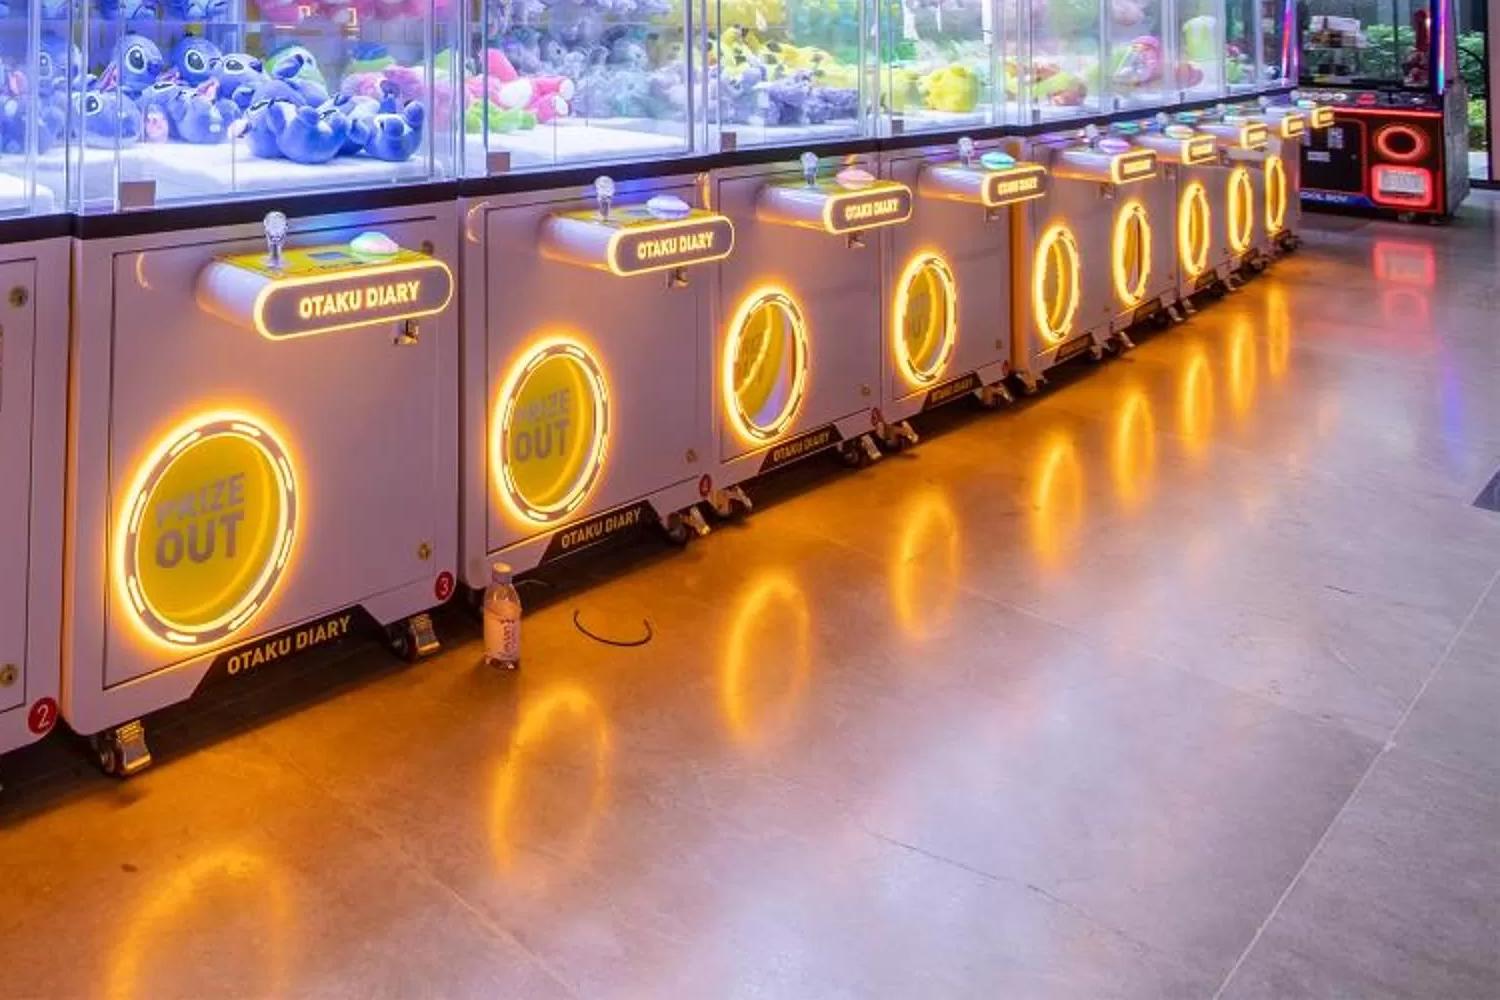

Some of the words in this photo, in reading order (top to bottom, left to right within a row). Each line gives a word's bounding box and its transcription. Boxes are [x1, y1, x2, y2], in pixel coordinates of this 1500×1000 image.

[636, 240, 678, 260] OTAKU
[679, 231, 716, 252] DIARY
[298, 291, 362, 320] OTAKU
[365, 279, 422, 308] DIARY
[514, 418, 569, 463] OUT
[154, 512, 246, 570] OUT
[560, 521, 601, 549] OTAKU
[604, 506, 642, 535] DIARY
[227, 637, 292, 676] OTAKU
[296, 615, 353, 650] DIARY
[35, 703, 53, 728] 2
